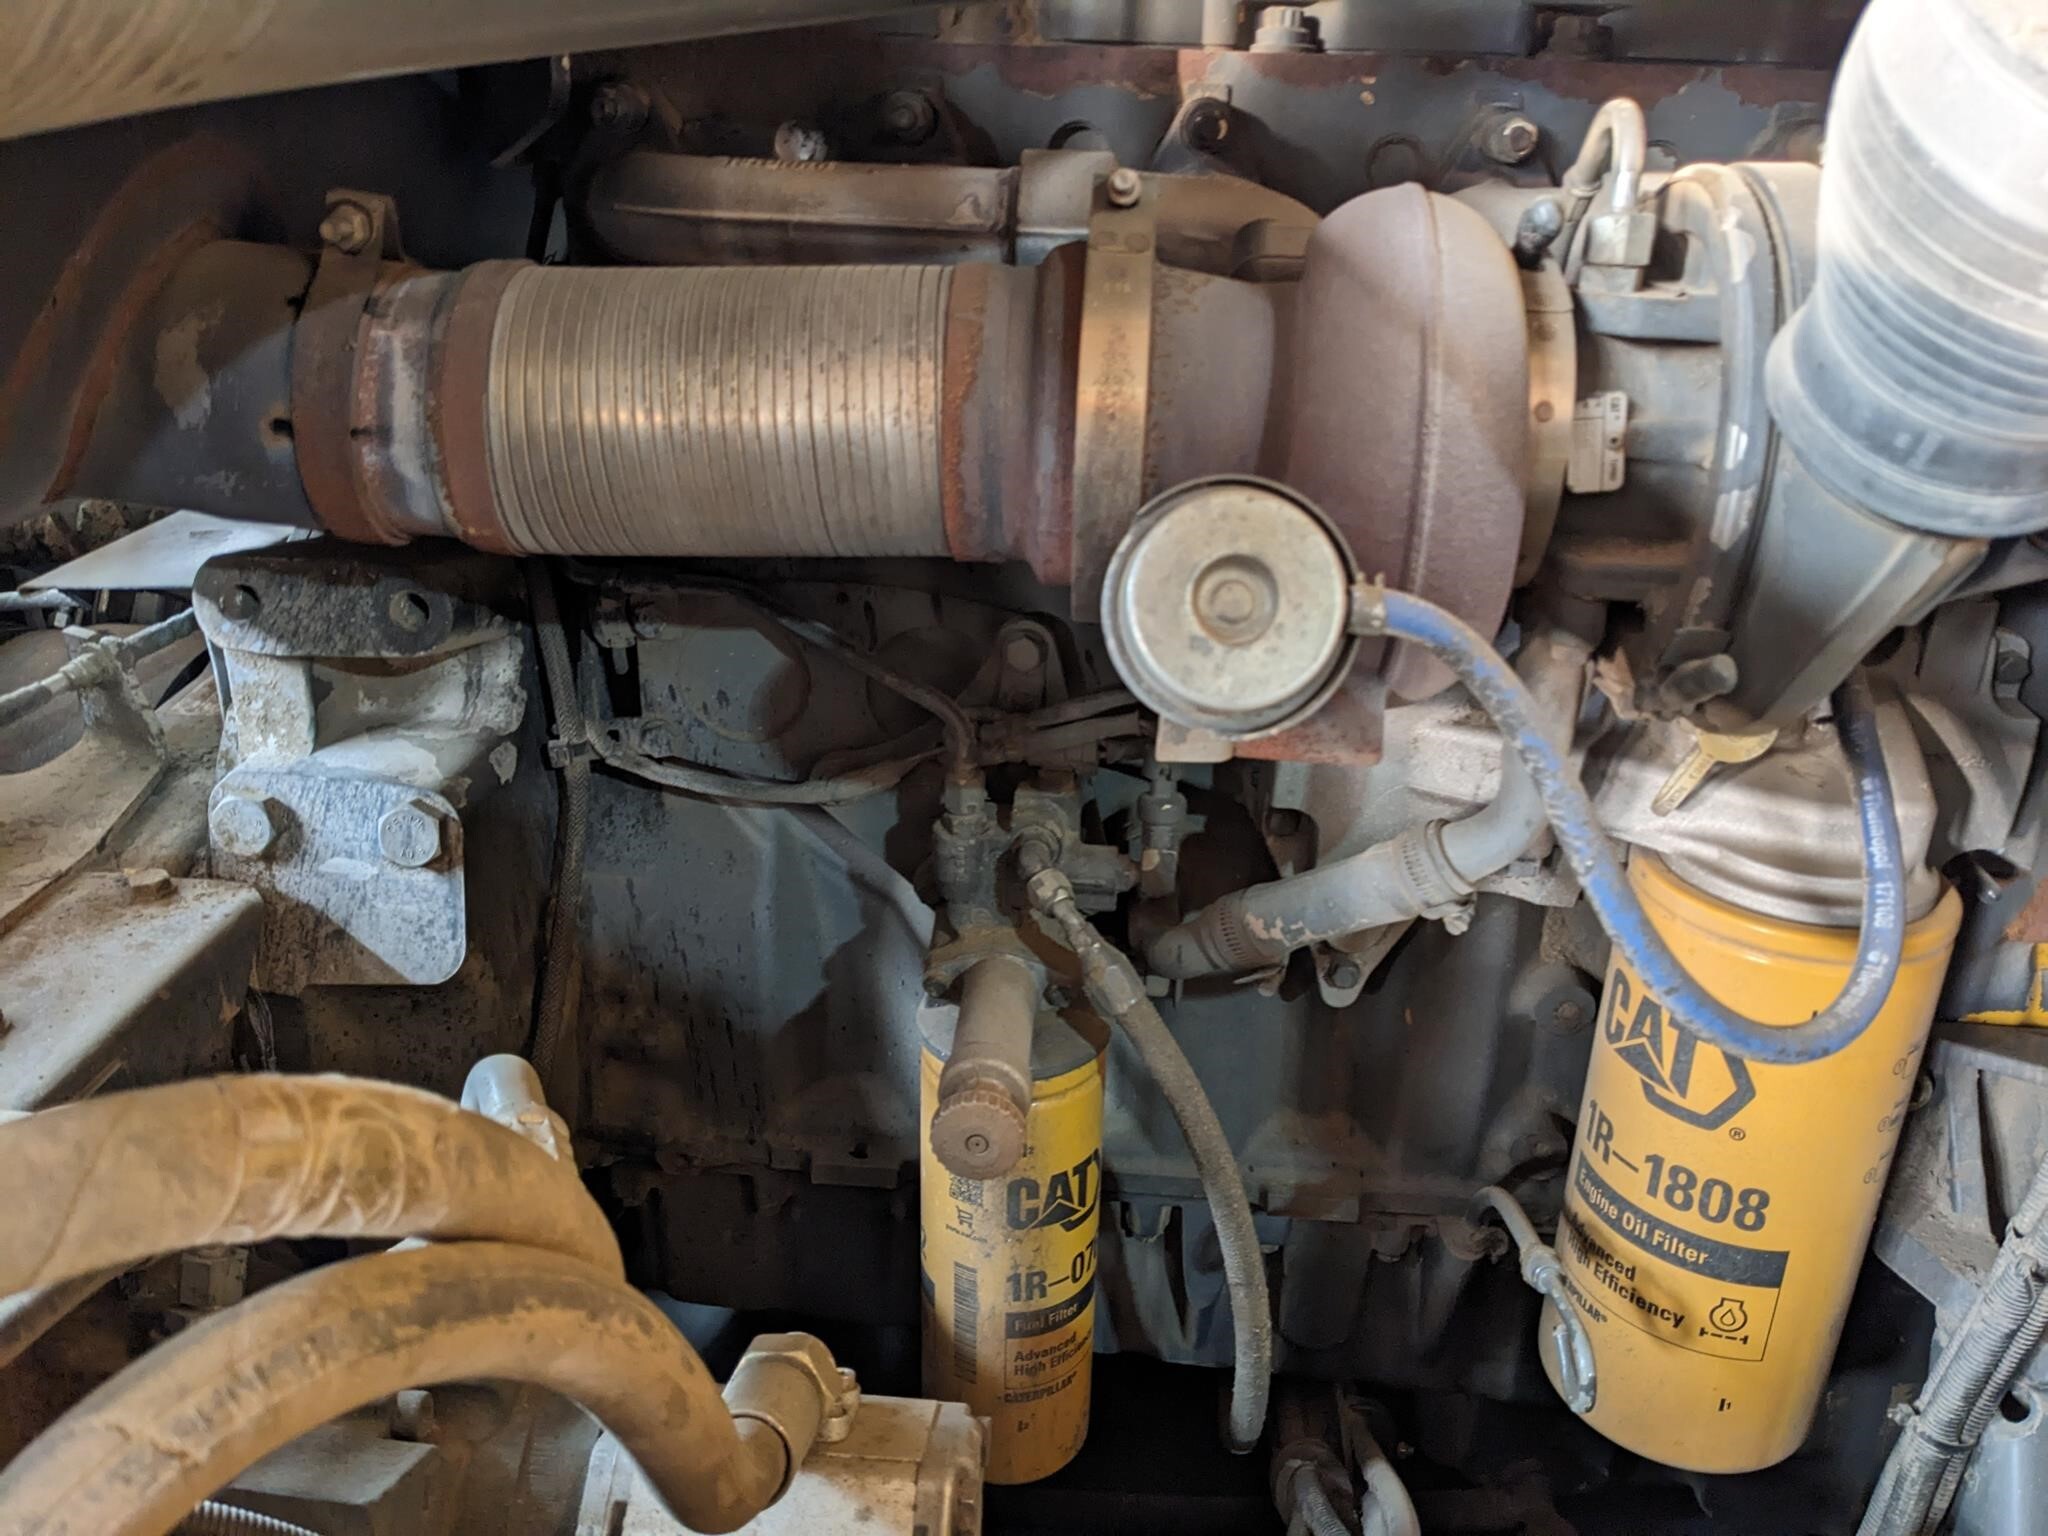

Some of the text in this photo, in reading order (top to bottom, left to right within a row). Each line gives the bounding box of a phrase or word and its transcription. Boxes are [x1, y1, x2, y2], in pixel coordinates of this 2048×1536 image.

[1604, 967, 1698, 1100] CAT
[1006, 1153, 1093, 1231] CAT
[1587, 1099, 1770, 1232] 1R-1808
[1579, 1170, 1709, 1265] Engine Oil Filter
[1006, 1238, 1097, 1302] 1R-07
[1594, 1260, 1686, 1329] Efficiency
[1014, 1331, 1077, 1363] Advanced
[1049, 1303, 1079, 1326] Filter
[1014, 1360, 1046, 1377] High
